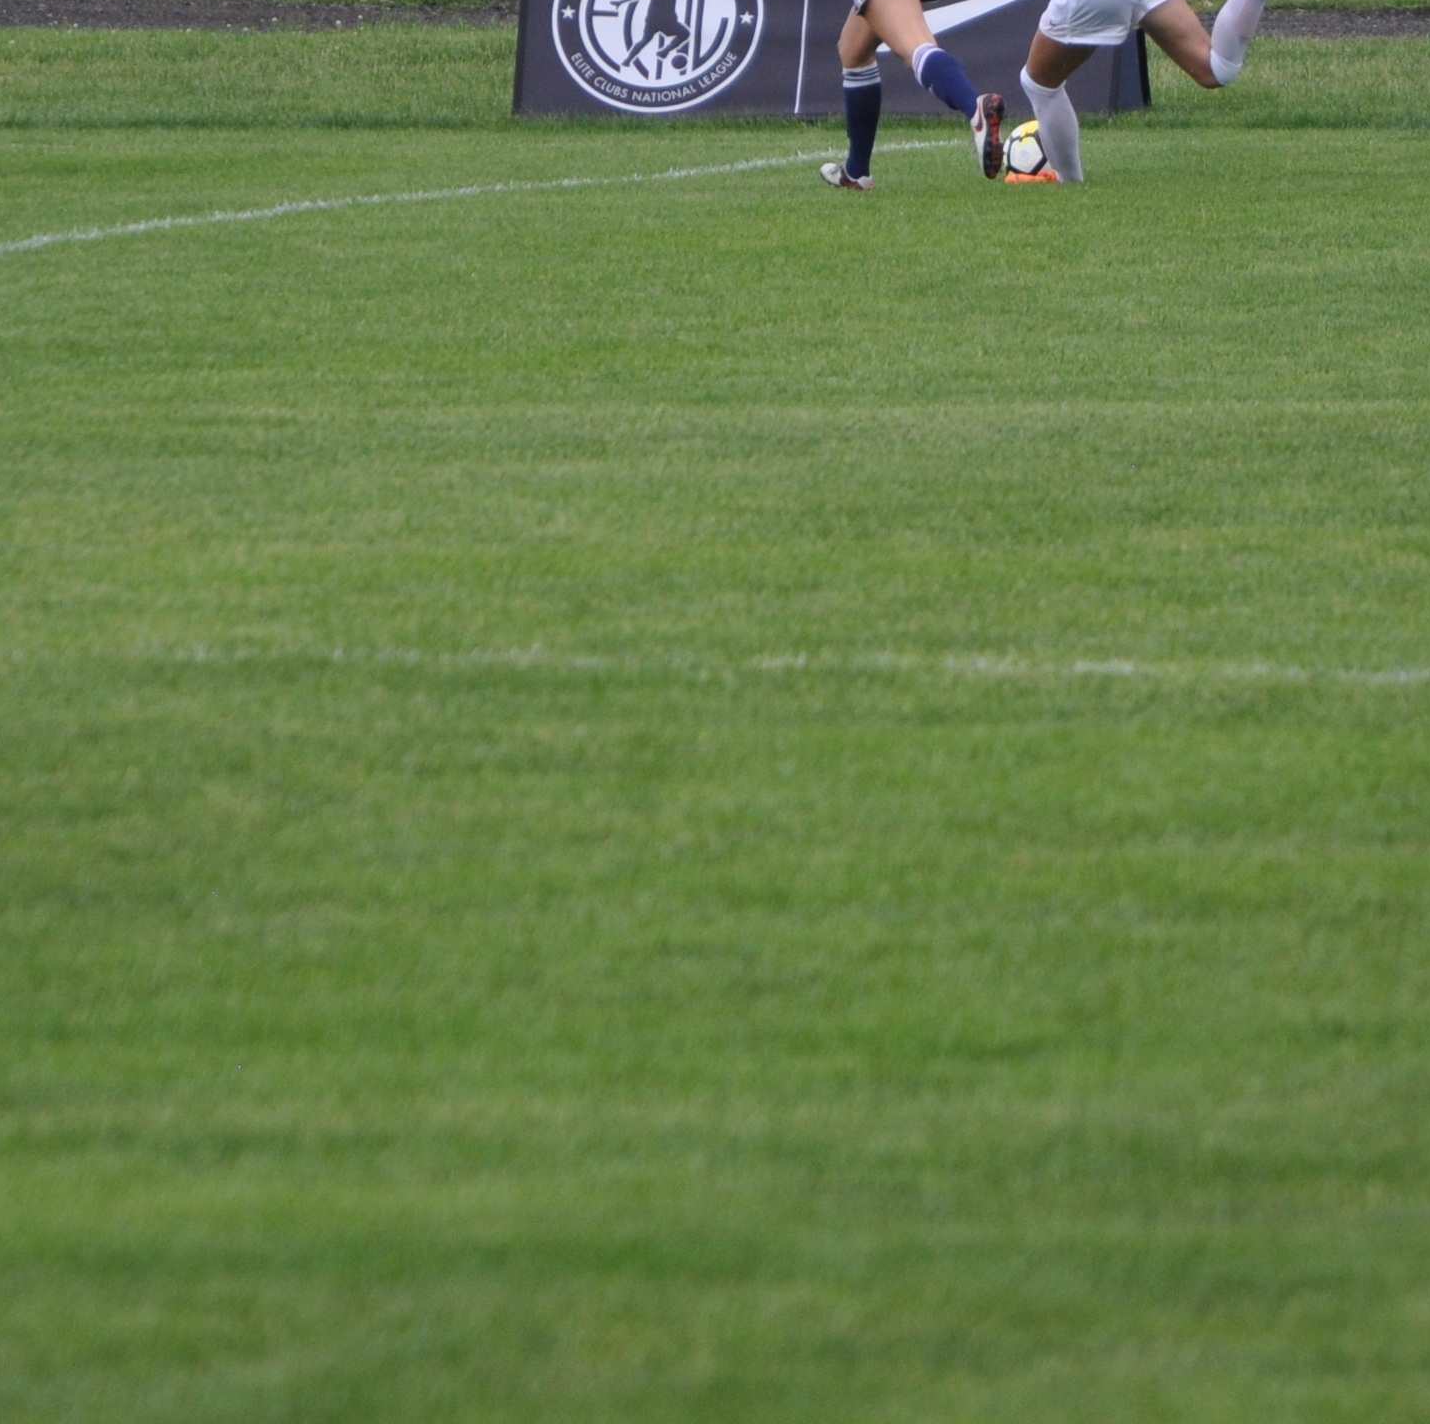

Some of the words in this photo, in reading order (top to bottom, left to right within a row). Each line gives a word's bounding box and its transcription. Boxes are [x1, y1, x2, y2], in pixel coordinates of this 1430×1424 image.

[571, 51, 596, 79] ELITE
[593, 76, 629, 99] CLUBS
[631, 84, 697, 103] NATIONAL
[698, 51, 738, 89] LEAGUE
